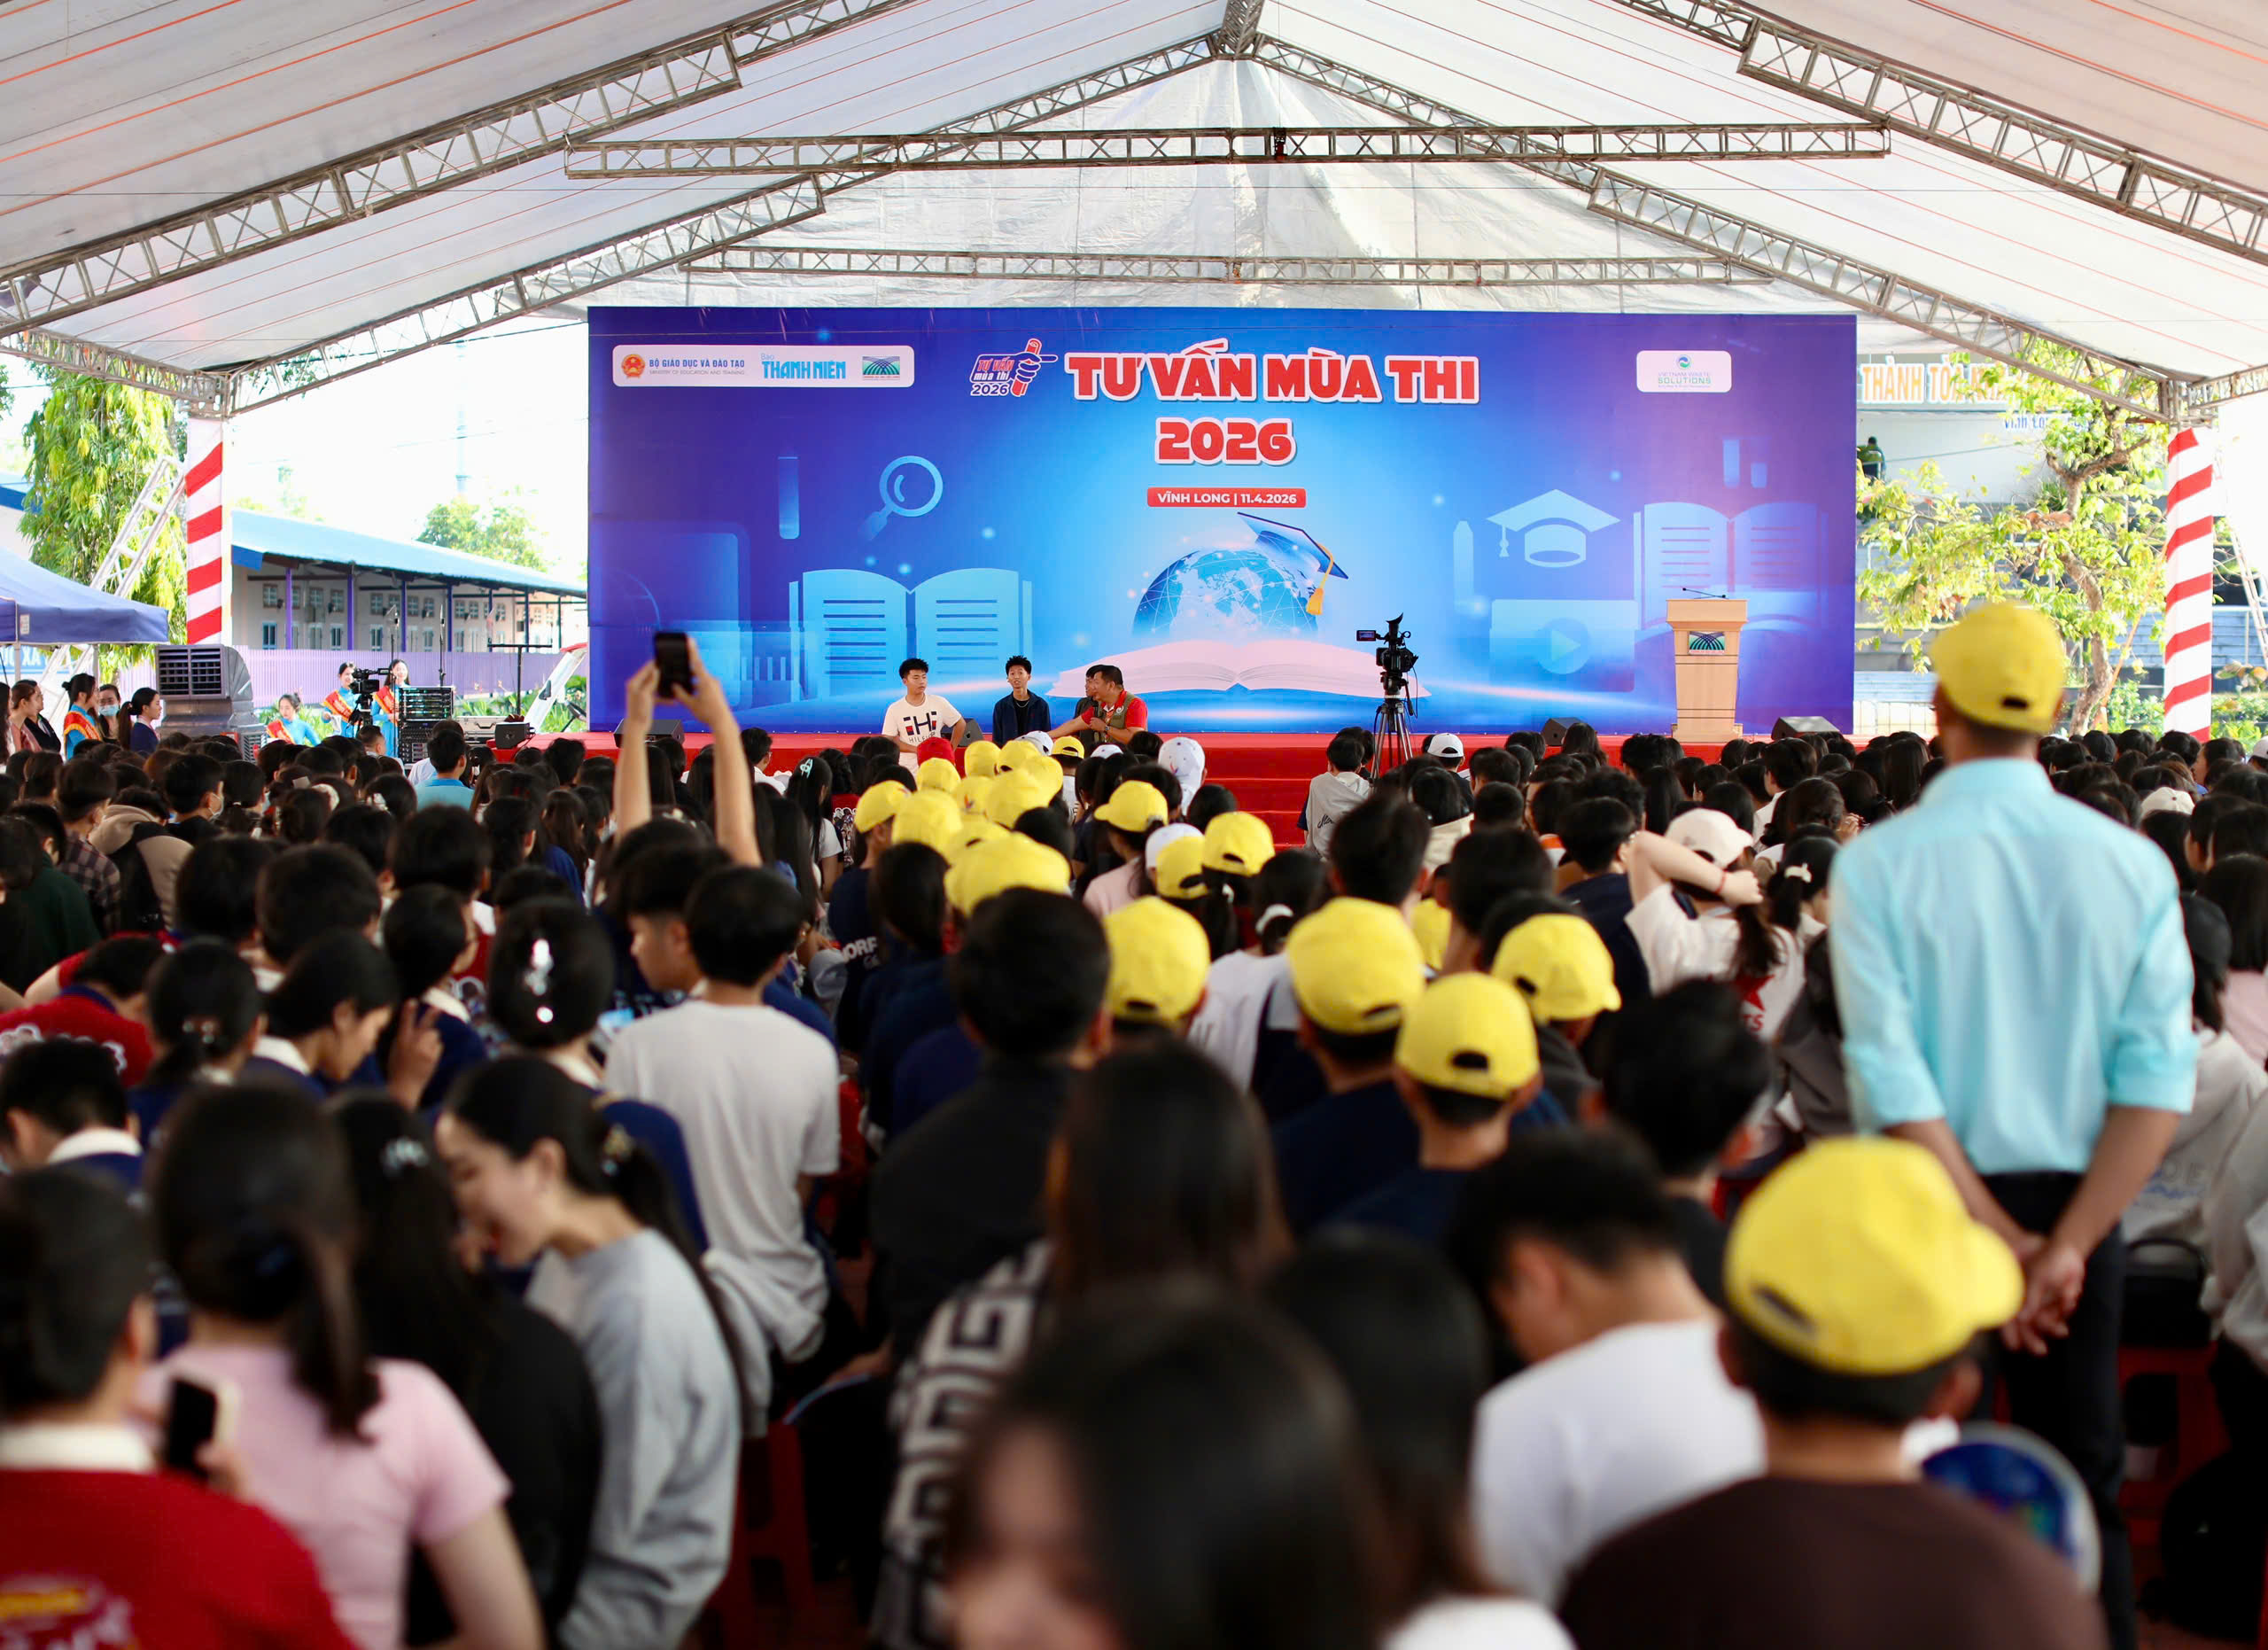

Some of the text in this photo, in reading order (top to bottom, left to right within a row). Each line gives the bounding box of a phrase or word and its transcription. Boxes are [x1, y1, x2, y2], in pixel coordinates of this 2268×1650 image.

[762, 361, 811, 378] THANH
[997, 371, 1010, 381] thi
[1066, 339, 1479, 401] TƯ VẤN MÙA THI
[971, 384, 1008, 396] 2026
[1156, 418, 1296, 463] 2026
[1157, 491, 1191, 503] VĨNH
[1194, 493, 1231, 503] LONG
[1240, 493, 1297, 504] 11.4.2026
